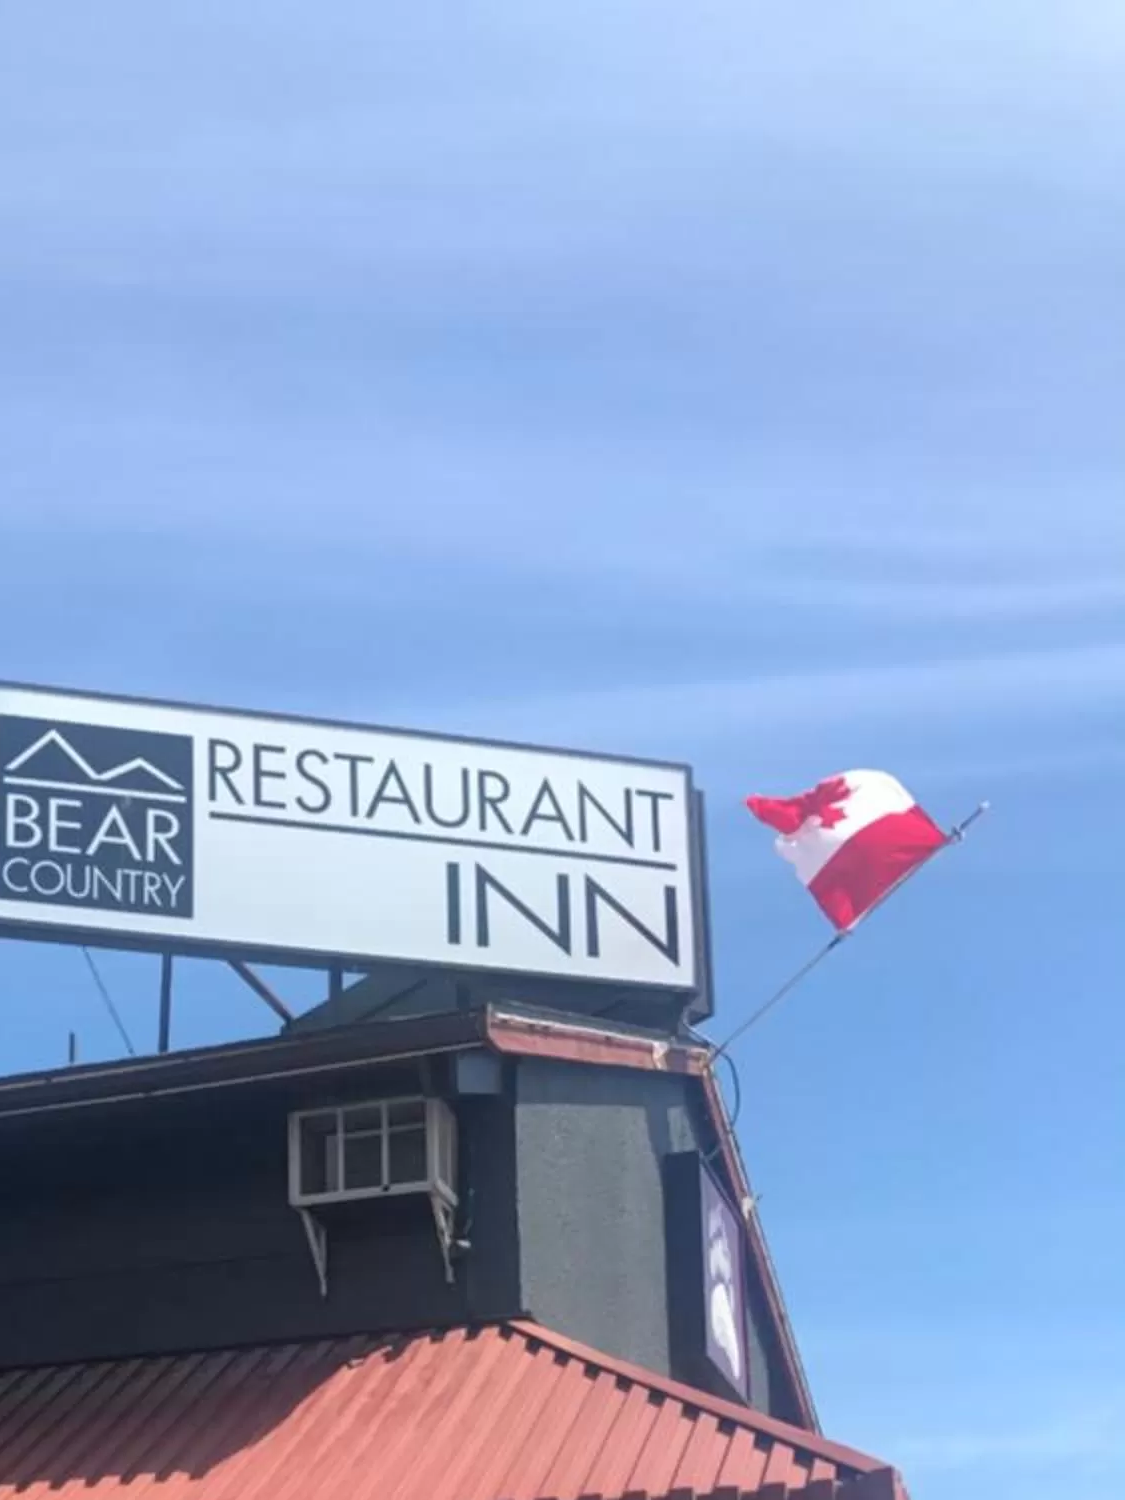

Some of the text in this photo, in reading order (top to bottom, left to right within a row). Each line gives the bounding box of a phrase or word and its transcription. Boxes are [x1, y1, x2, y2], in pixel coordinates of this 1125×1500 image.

[6, 793, 182, 865] BEAR
[207, 737, 674, 852] RESTAURANT
[2, 856, 185, 908] COUNTRY
[447, 861, 680, 967] INN
